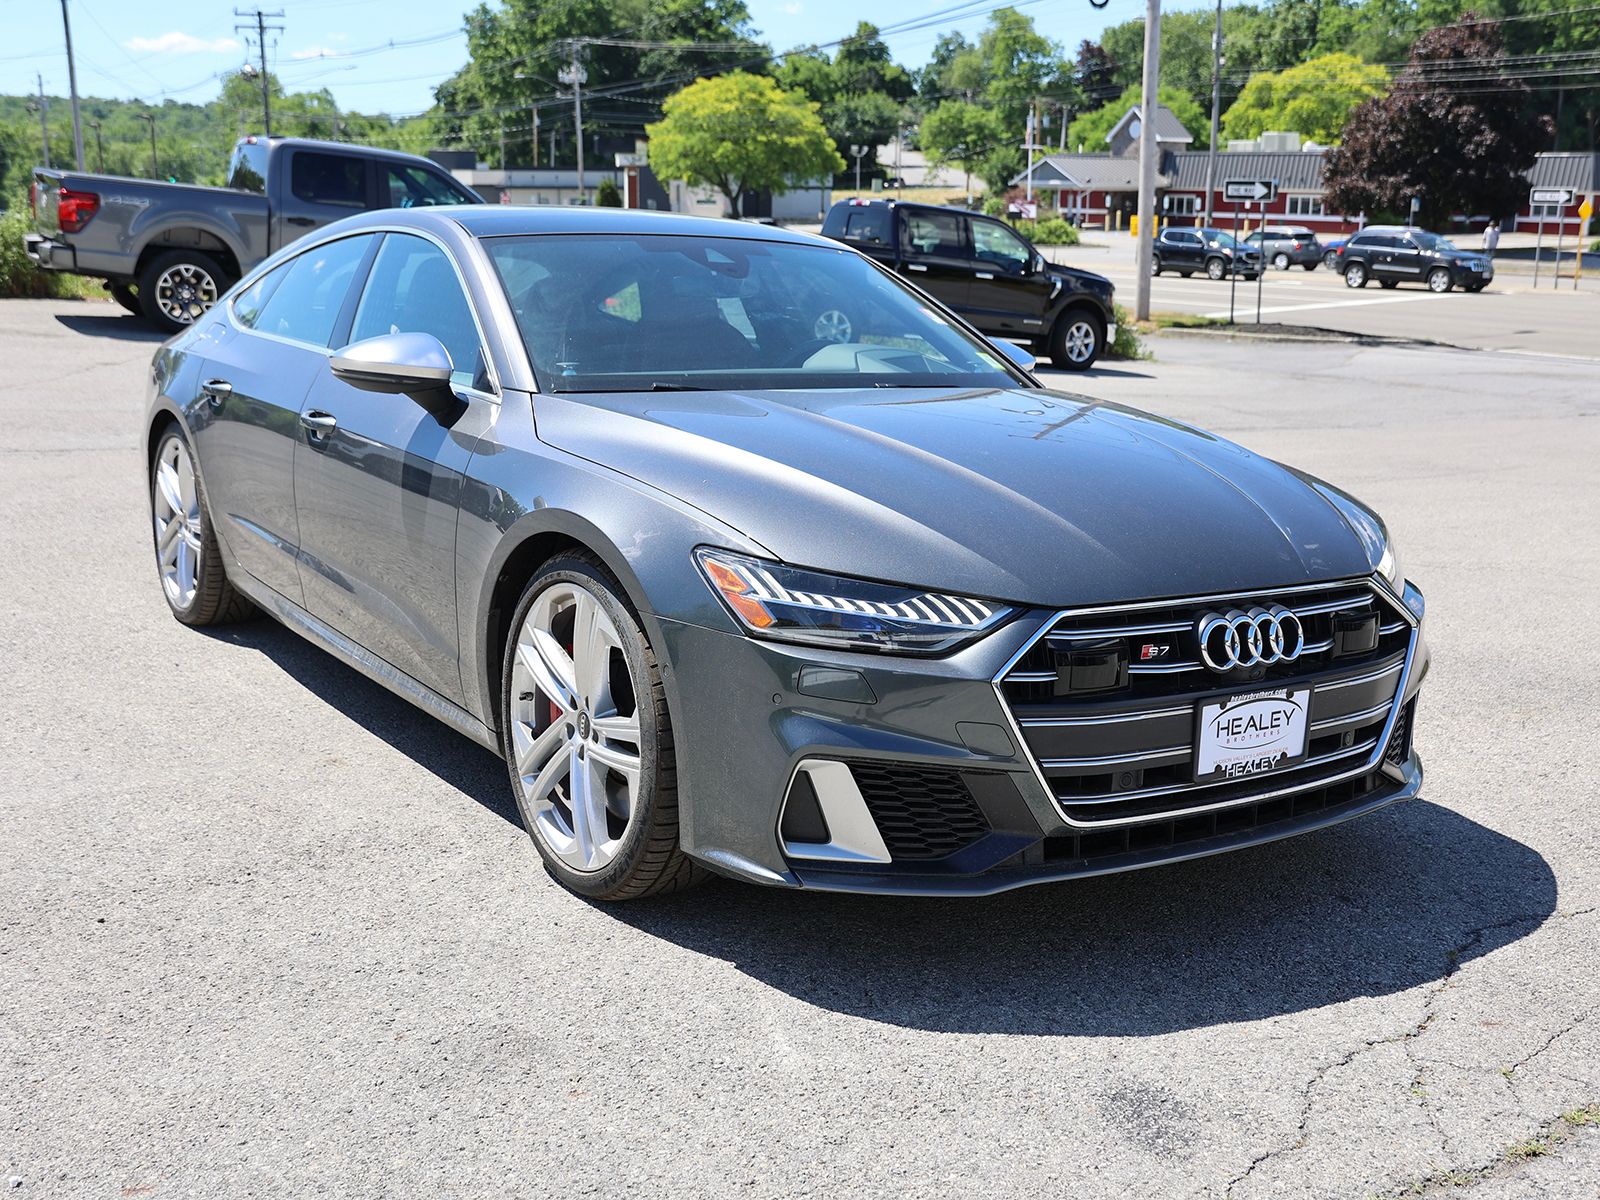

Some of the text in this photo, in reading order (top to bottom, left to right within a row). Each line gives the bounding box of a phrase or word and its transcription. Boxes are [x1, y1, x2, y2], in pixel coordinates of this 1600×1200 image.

[1146, 645, 1170, 657] S7
[1216, 708, 1296, 738] HEALEY
[1226, 730, 1280, 744] BROTHERS
[1226, 756, 1278, 778] HEALEY
